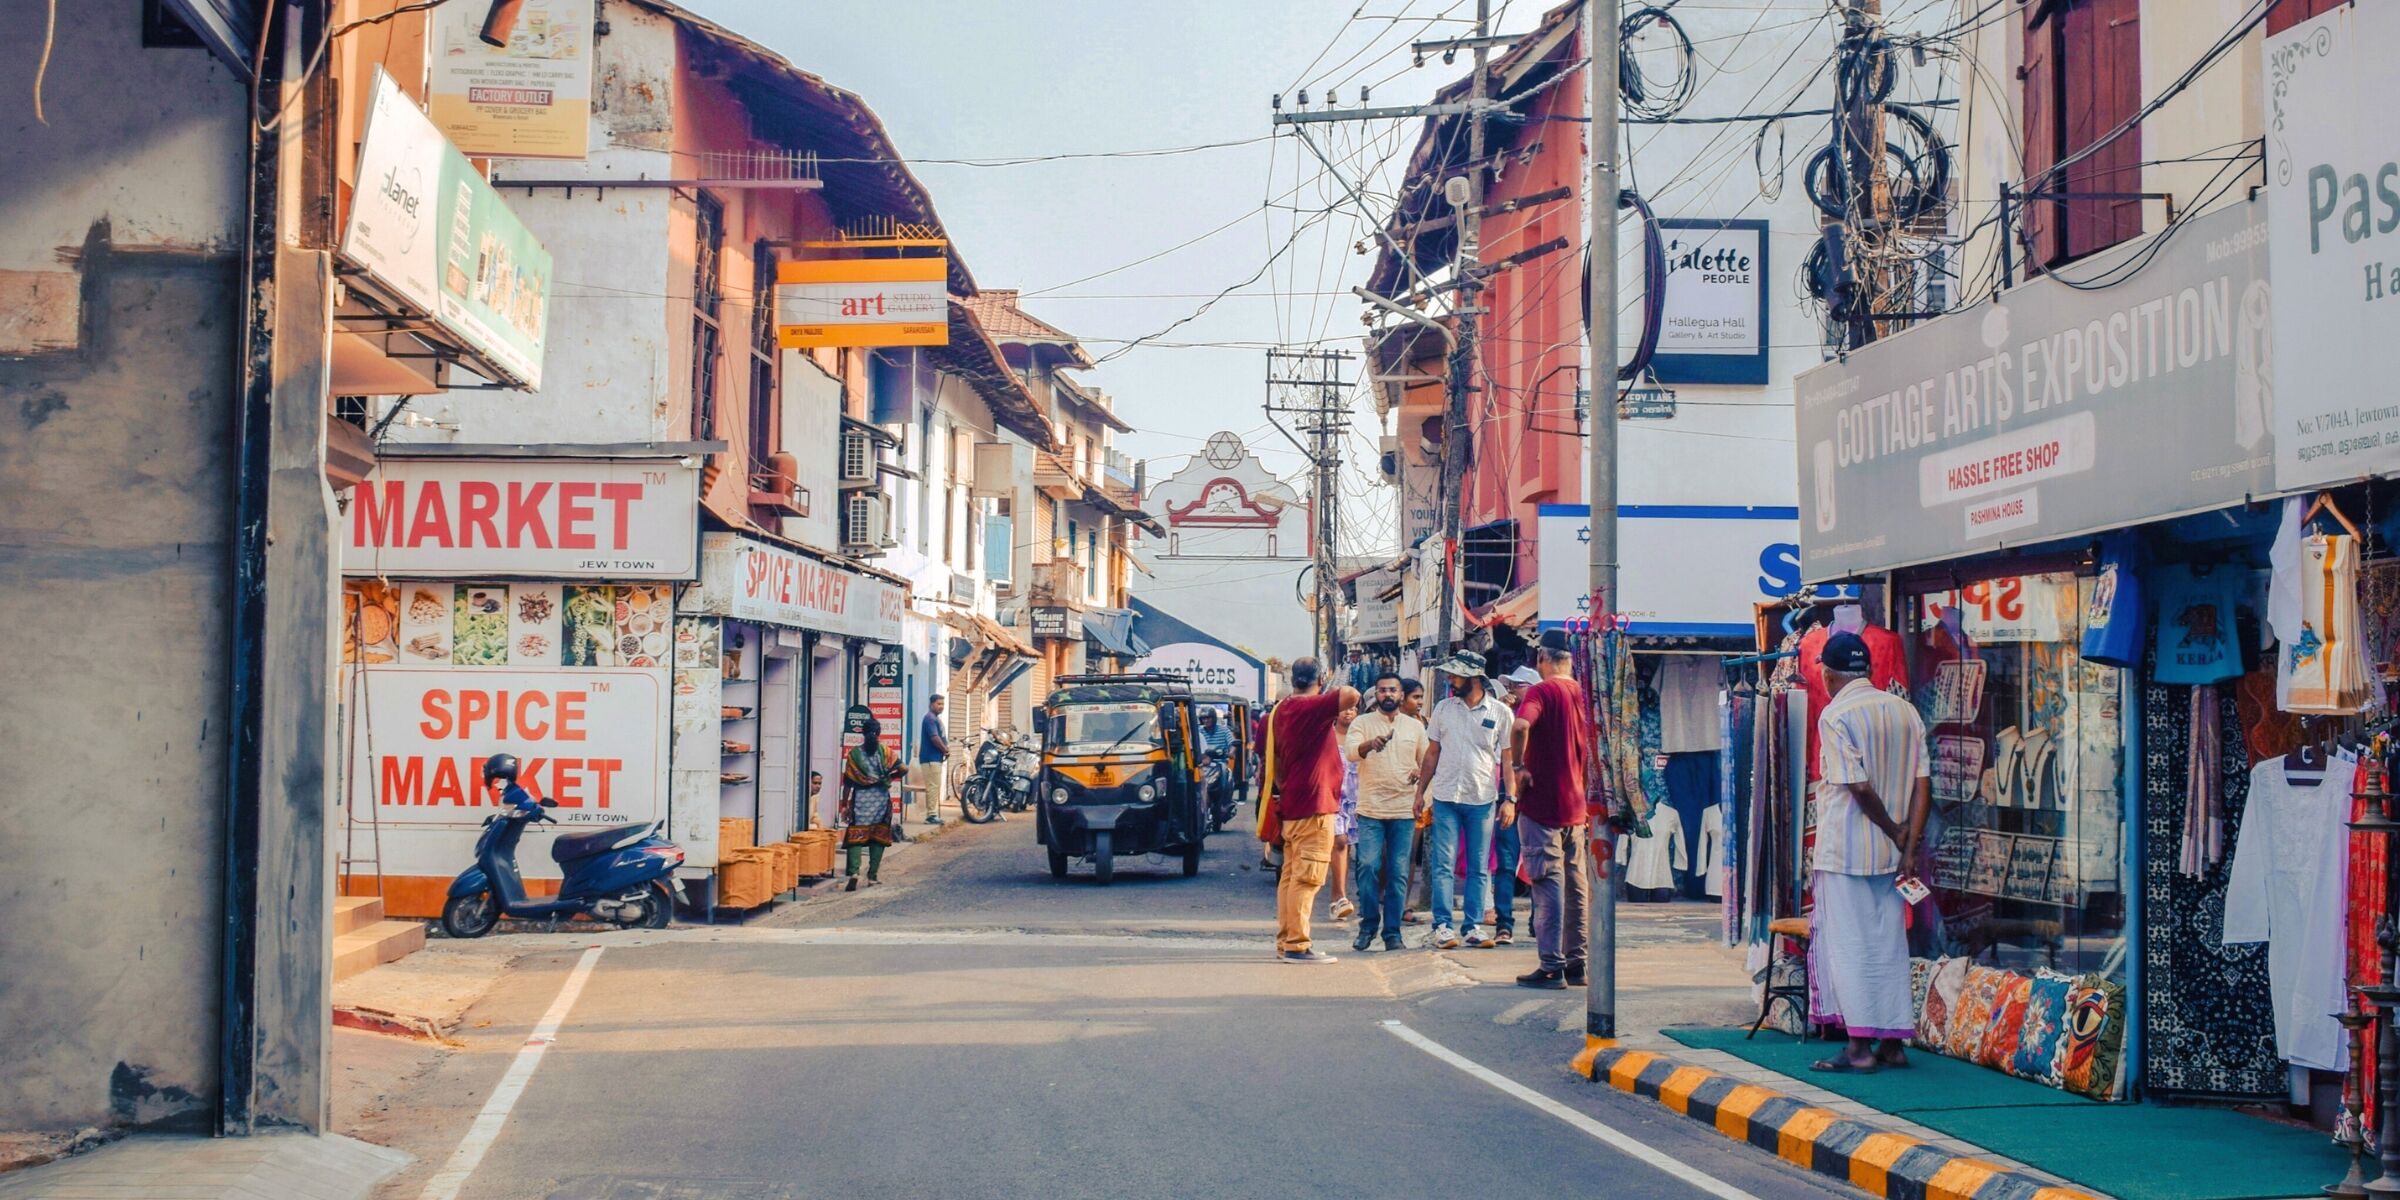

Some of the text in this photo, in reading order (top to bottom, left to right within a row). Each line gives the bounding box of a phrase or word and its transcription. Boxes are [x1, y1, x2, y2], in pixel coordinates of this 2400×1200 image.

[471, 88, 550, 105] FACTORY OUTLET
[1702, 274, 1750, 284] PEOPLE
[893, 293, 932, 302] STUDIO
[841, 292, 886, 317] art
[888, 303, 936, 313] GALLERY
[1668, 316, 1745, 329] Hallegua Hall
[1668, 331, 1695, 340] Gallery
[1707, 331, 1719, 339] Art
[1720, 331, 1746, 339] Studio
[1836, 275, 2230, 468] COTTAGE ARTS EXPOSITION
[2297, 419, 2313, 436] No:
[2355, 405, 2399, 428] Jewtown
[1948, 441, 2060, 491] HASSLE FREE SHOP
[352, 472, 666, 550] MARKET TM
[1410, 509, 1436, 520] YOUR
[1970, 499, 2024, 526] PASHMINA HOUSE
[579, 561, 655, 569] JEW TOWN
[745, 550, 849, 615] SPICE MARKET
[1034, 613, 1064, 621] ORGANIC
[873, 664, 898, 677] OILS
[419, 682, 611, 742] SPICE TM
[891, 723, 900, 731] OIL
[568, 813, 629, 823] JEW TOWN
